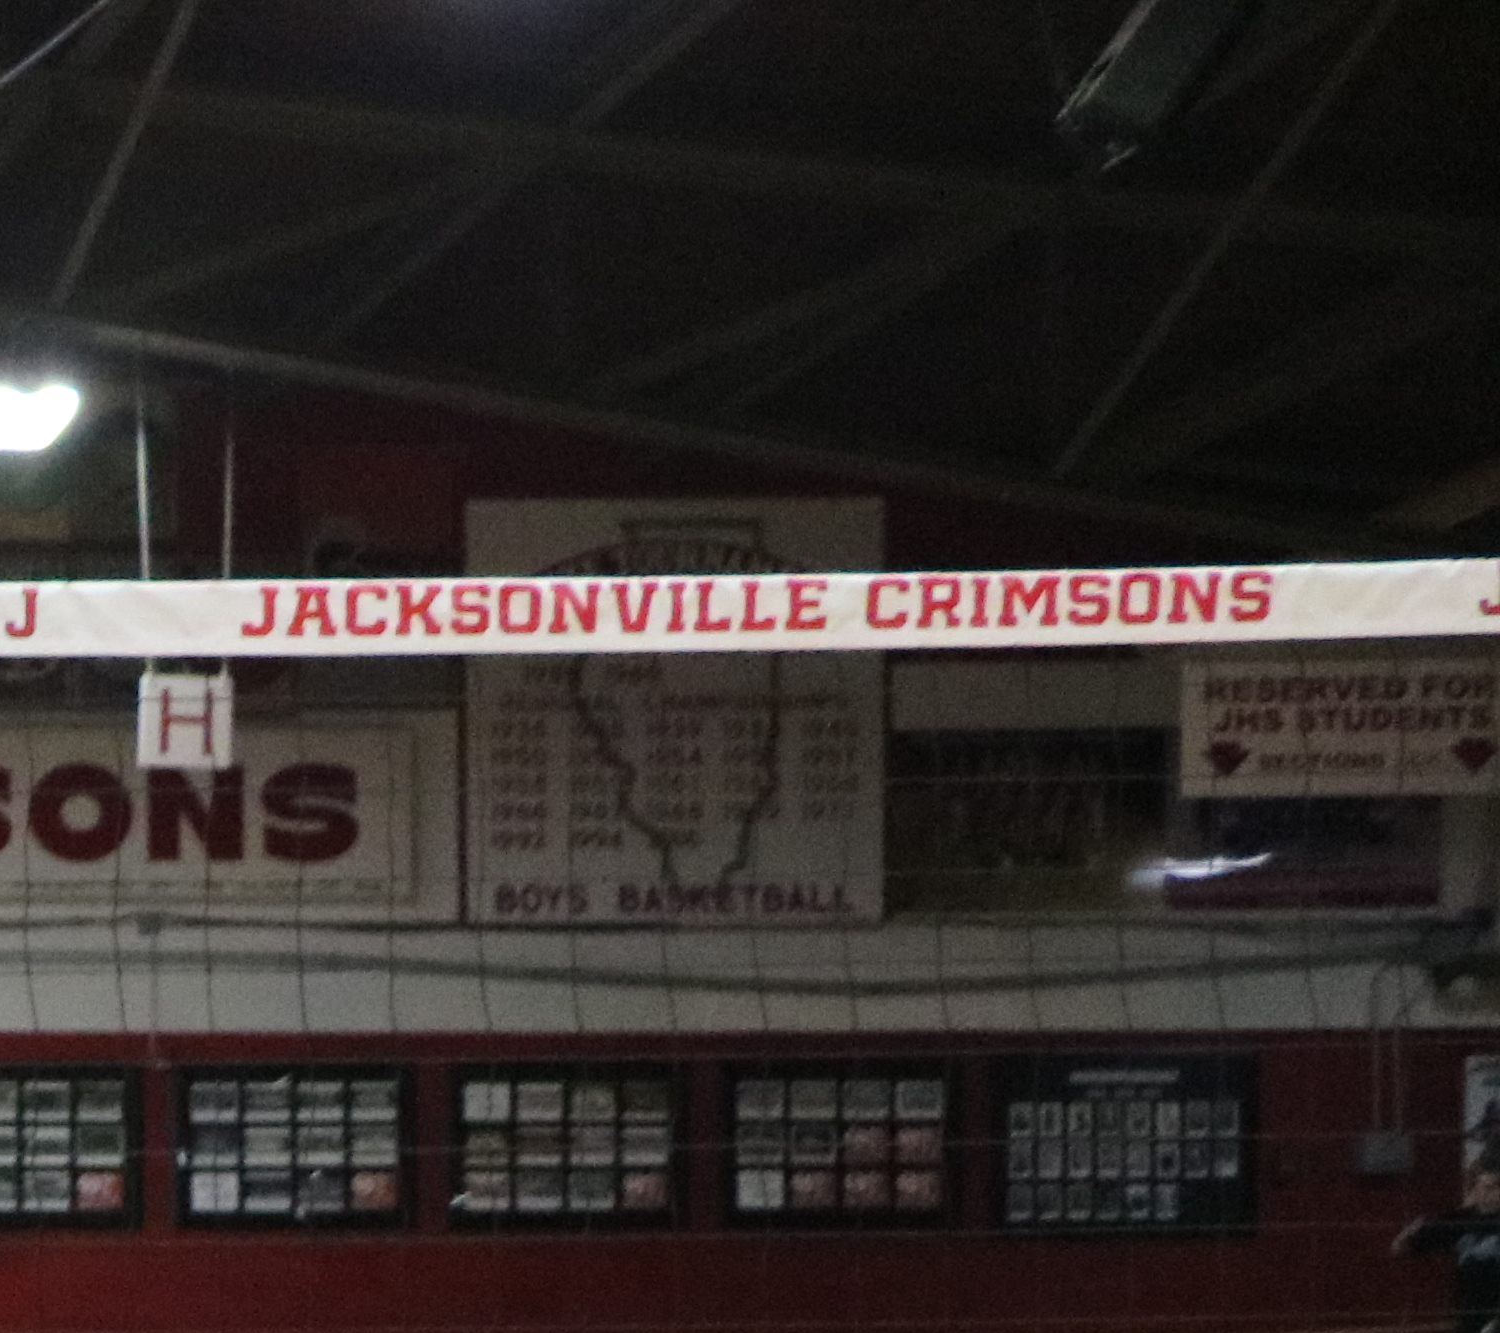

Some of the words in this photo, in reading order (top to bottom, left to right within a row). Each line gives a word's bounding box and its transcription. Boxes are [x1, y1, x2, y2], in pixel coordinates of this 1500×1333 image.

[4, 586, 39, 639] J
[241, 577, 830, 638] JACKSONVILLE
[865, 569, 1275, 631] CRIMSONS
[1204, 676, 1407, 704] RESERVED
[1421, 673, 1496, 701] FOR
[159, 687, 218, 757] H
[1214, 708, 1284, 733] JHS
[1297, 704, 1493, 733] STUDENTS
[494, 884, 589, 914] BOYS
[618, 881, 854, 914] BASKETBALL
